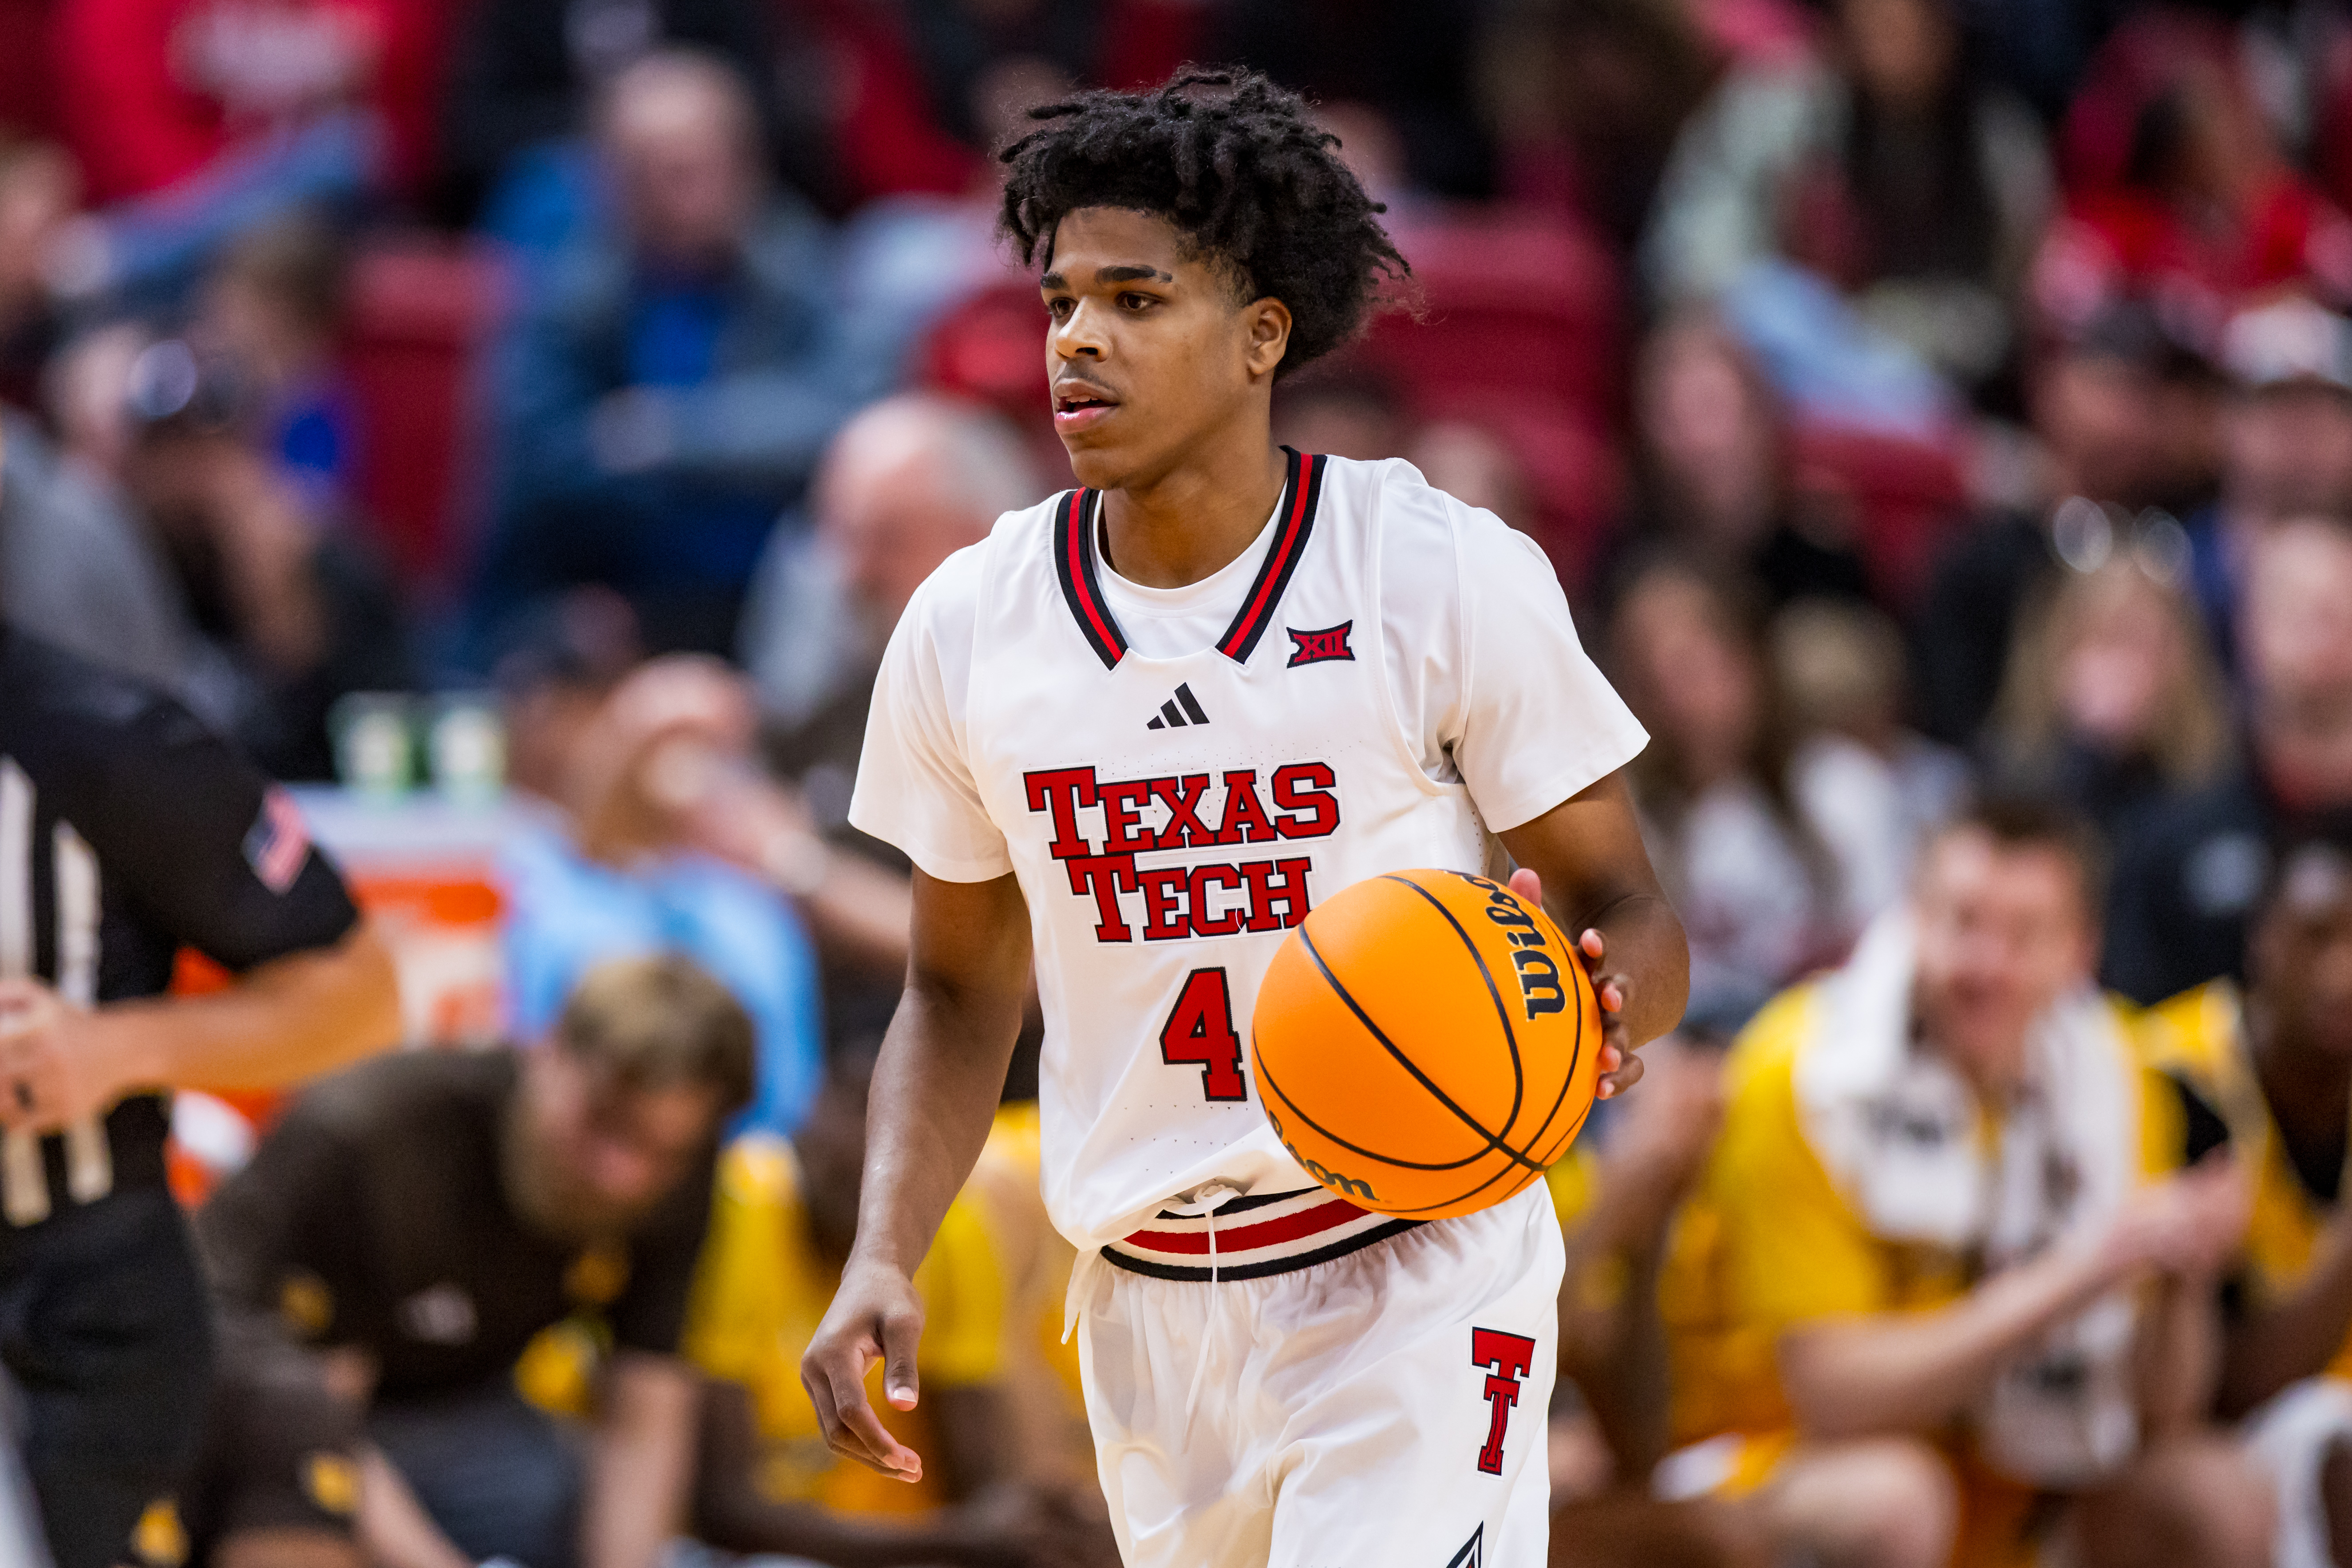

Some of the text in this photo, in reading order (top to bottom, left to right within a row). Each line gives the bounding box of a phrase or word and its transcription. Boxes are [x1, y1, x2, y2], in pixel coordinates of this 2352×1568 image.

[1288, 622, 1353, 666] XII
[1022, 761, 1341, 860] TEXAS
[1065, 854, 1313, 943] TECH
[1444, 869, 1566, 1022] Wilso
[1159, 966, 1247, 1102] 4
